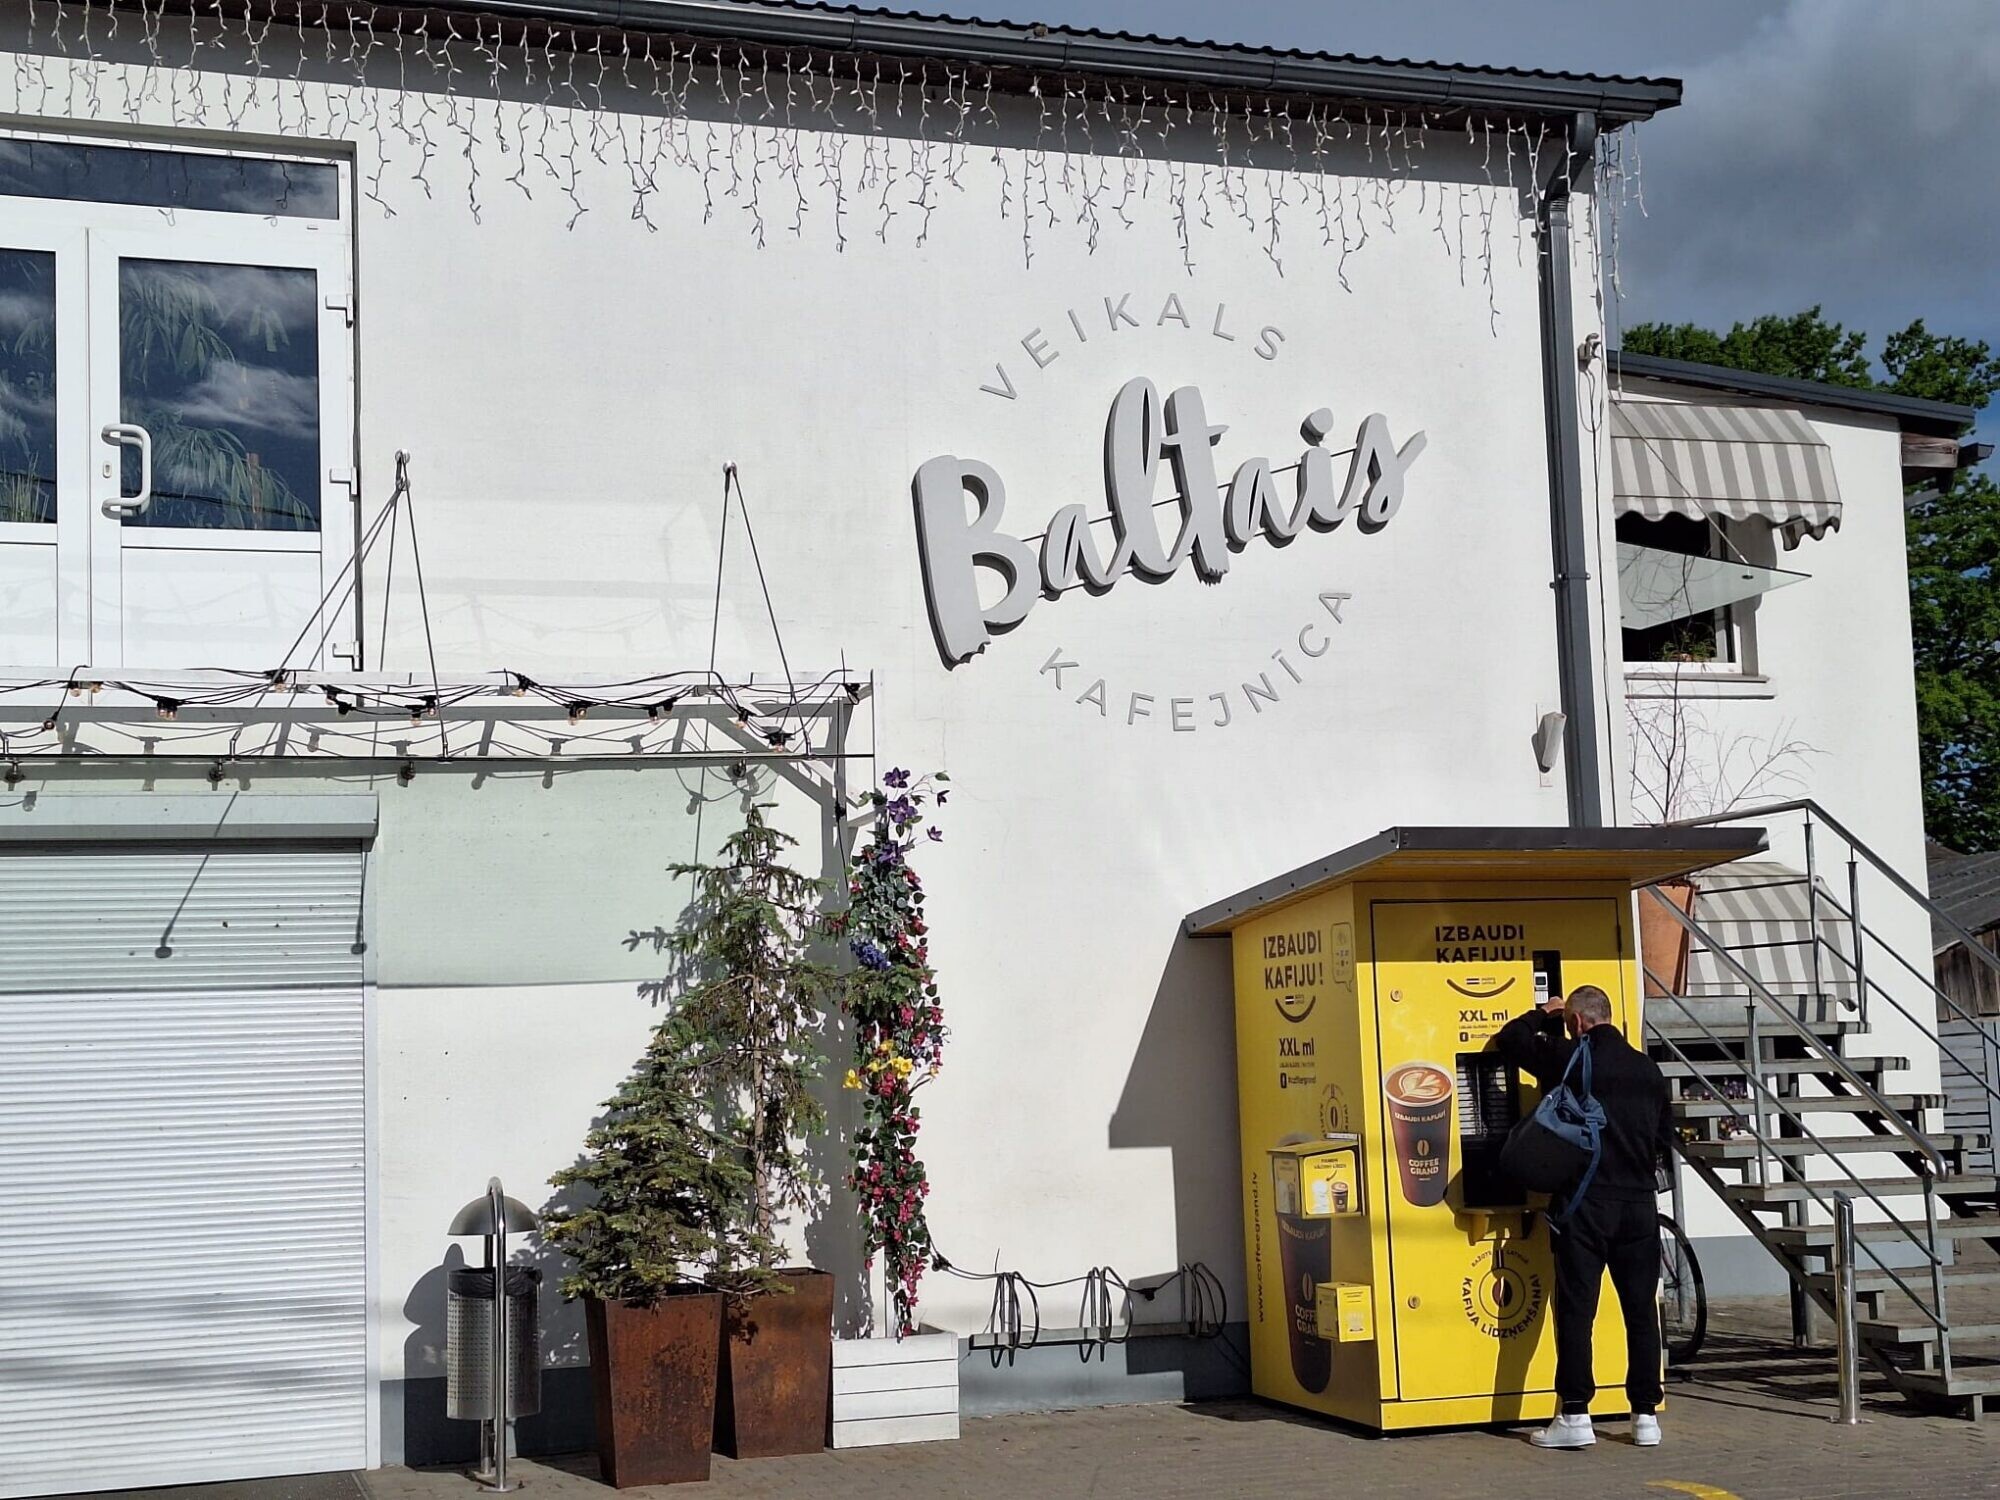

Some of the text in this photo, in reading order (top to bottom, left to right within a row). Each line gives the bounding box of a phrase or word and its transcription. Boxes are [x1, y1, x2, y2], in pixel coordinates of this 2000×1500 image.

[980, 293, 1287, 401] VEIKALS
[911, 375, 1428, 671] Baltais
[1039, 591, 1353, 733] KAFEJNĪCA
[1435, 924, 1525, 942] IZBAUDI
[1263, 930, 1322, 959] IZBAUDI
[1459, 1009, 1509, 1022] XXL ml
[1279, 1037, 1315, 1056] XXL ml
[1408, 1158, 1440, 1167] COFFEE
[1410, 1166, 1439, 1175] GRAND
[1252, 1172, 1265, 1323] www.coffeegrand.lv
[1462, 1277, 1480, 1327] KAFIJA
[1295, 1304, 1316, 1321] COFF
[1296, 1318, 1317, 1336] GRAN
